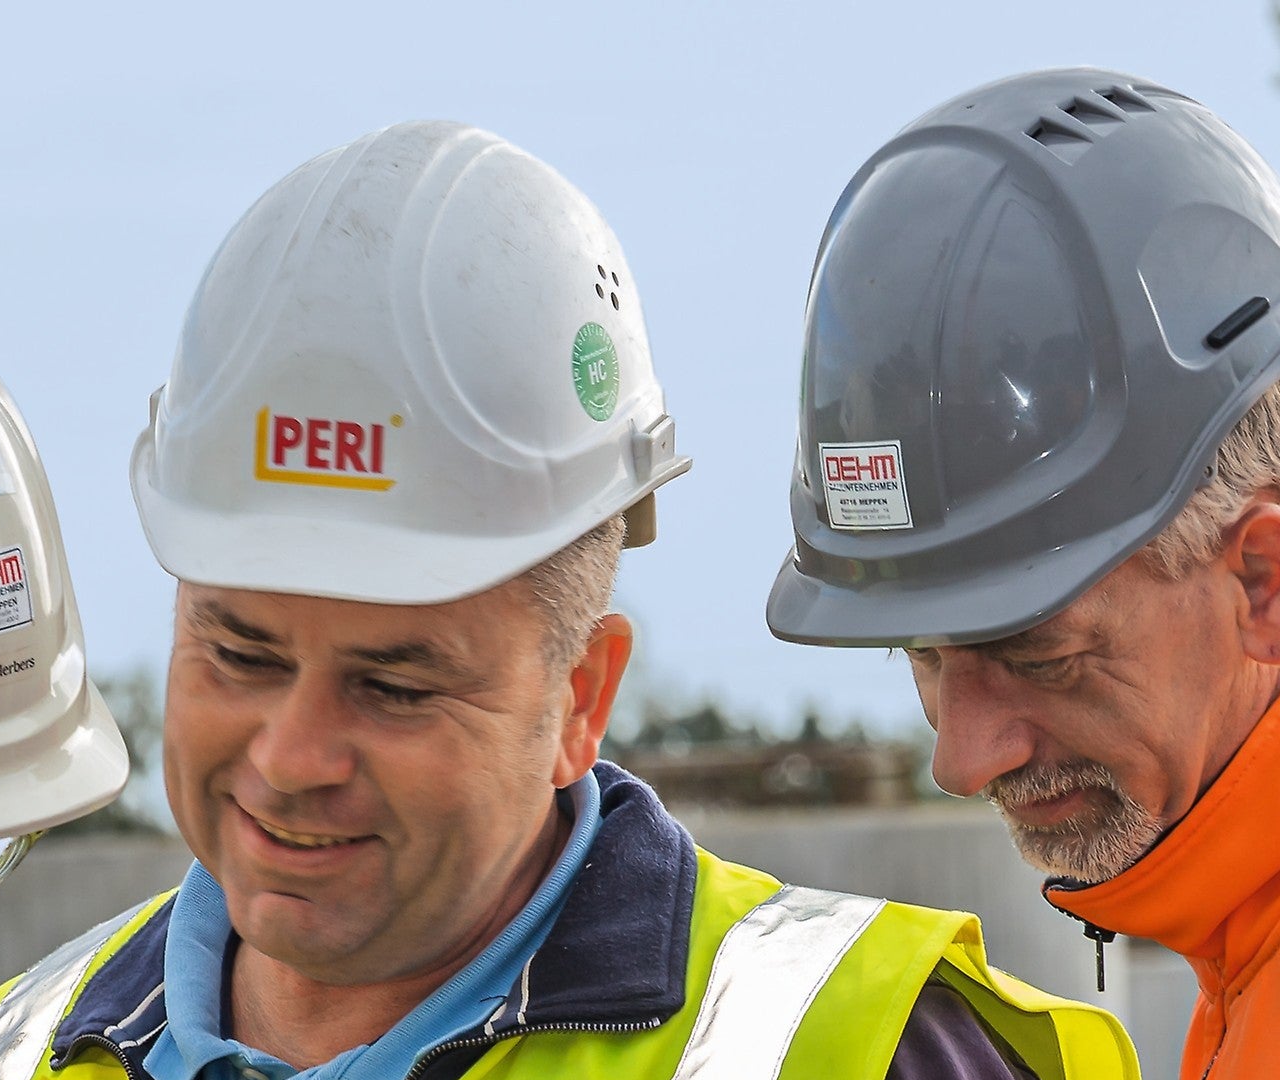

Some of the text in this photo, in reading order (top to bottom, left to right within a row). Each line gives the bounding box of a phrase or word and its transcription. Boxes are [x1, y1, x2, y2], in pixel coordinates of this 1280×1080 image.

[588, 359, 607, 386] HC
[273, 414, 384, 474] PERI
[825, 455, 897, 481] OEHM
